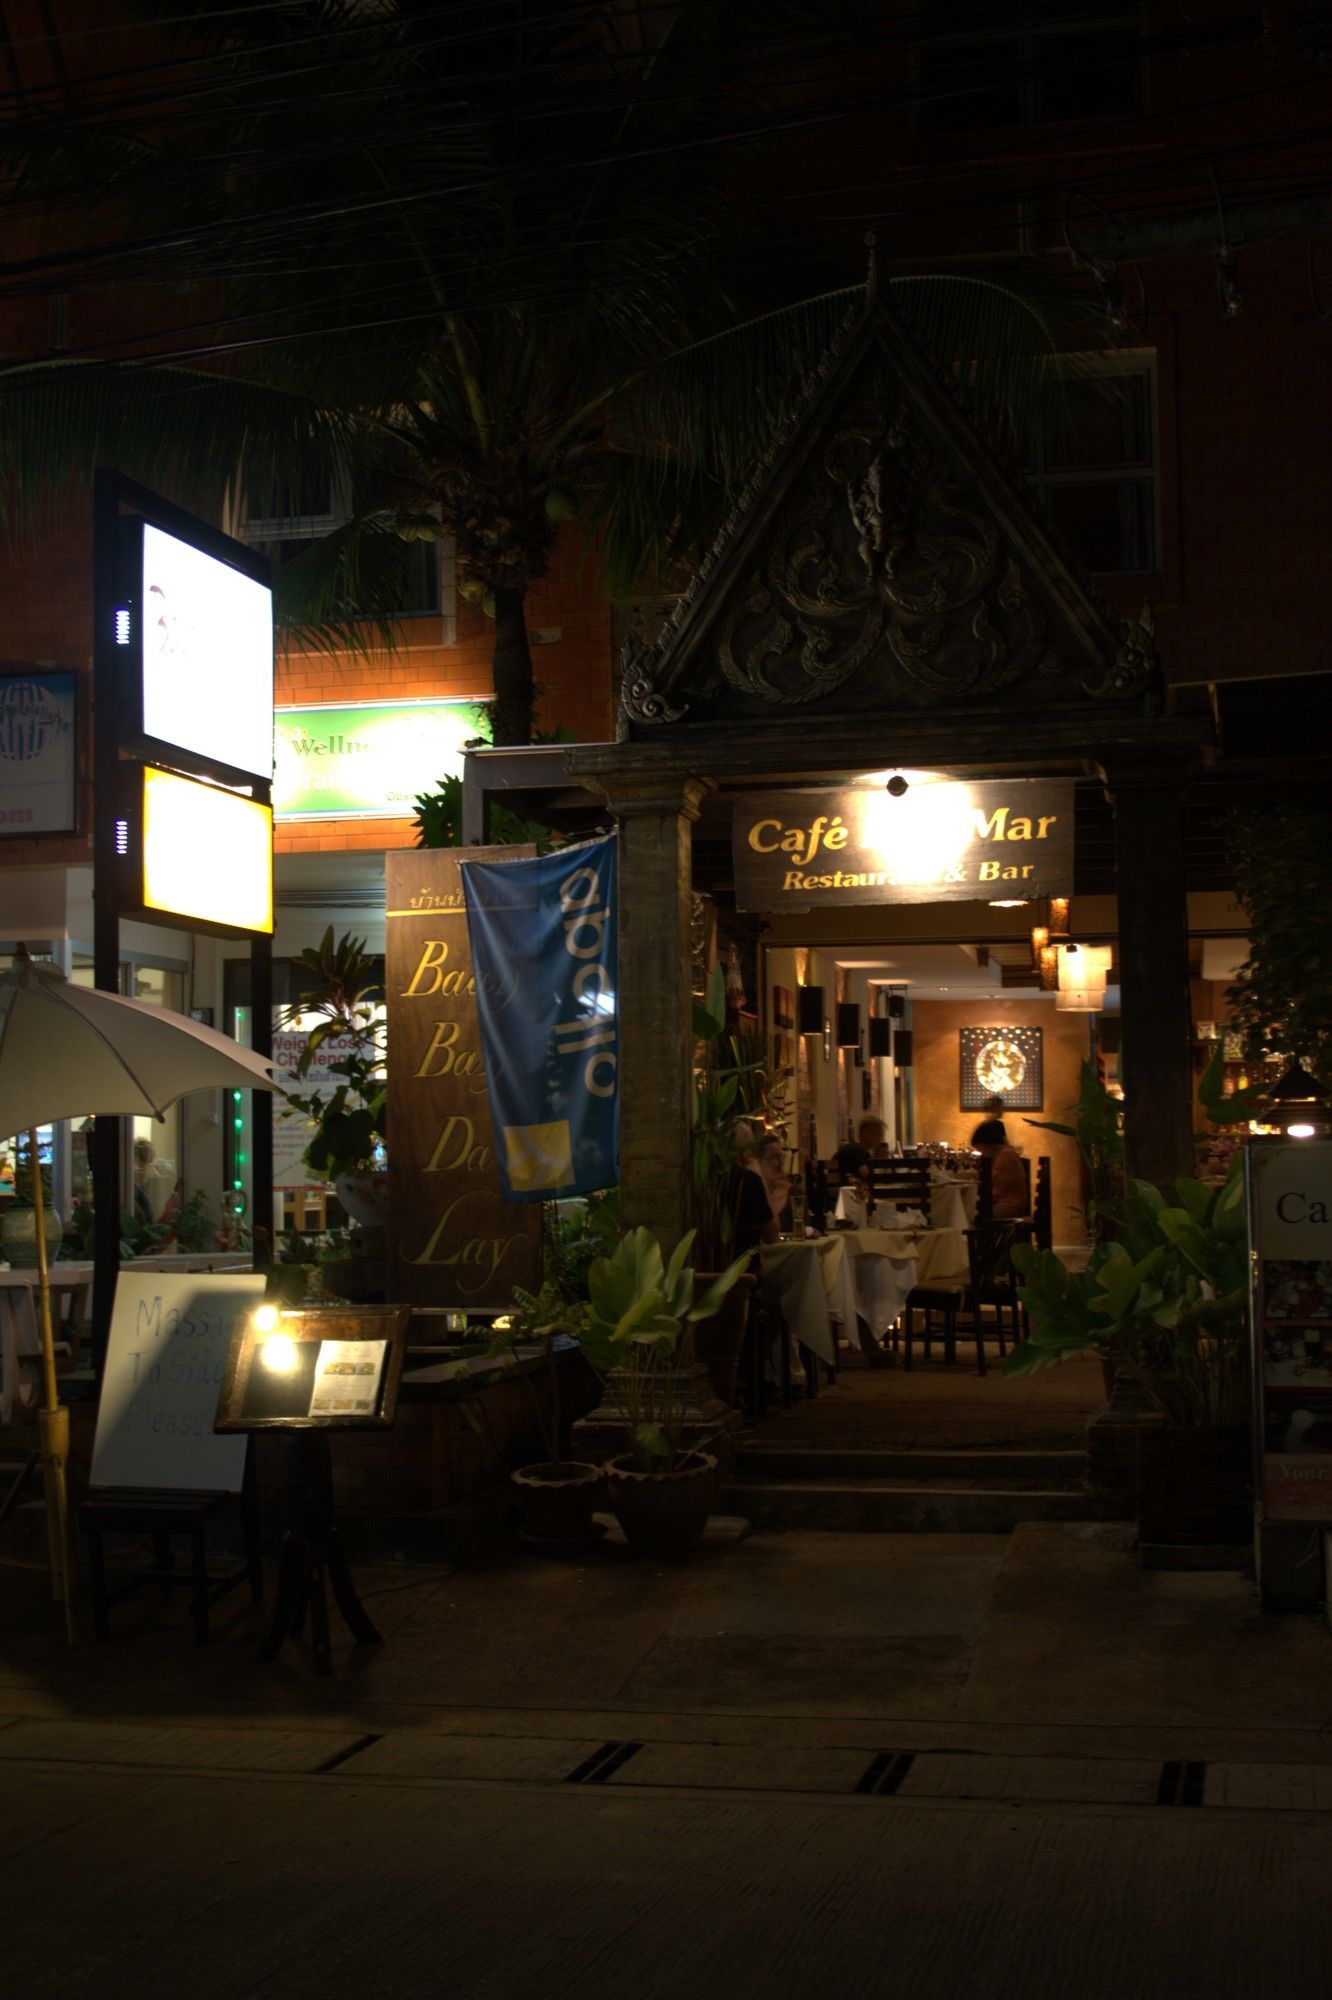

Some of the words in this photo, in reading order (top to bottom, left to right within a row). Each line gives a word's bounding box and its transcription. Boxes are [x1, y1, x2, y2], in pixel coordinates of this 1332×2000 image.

[748, 815, 849, 865] Café
[970, 806, 1057, 842] Mar
[978, 860, 1034, 882] Bar
[554, 867, 616, 1097] apollo
[402, 1190, 529, 1295] Lay
